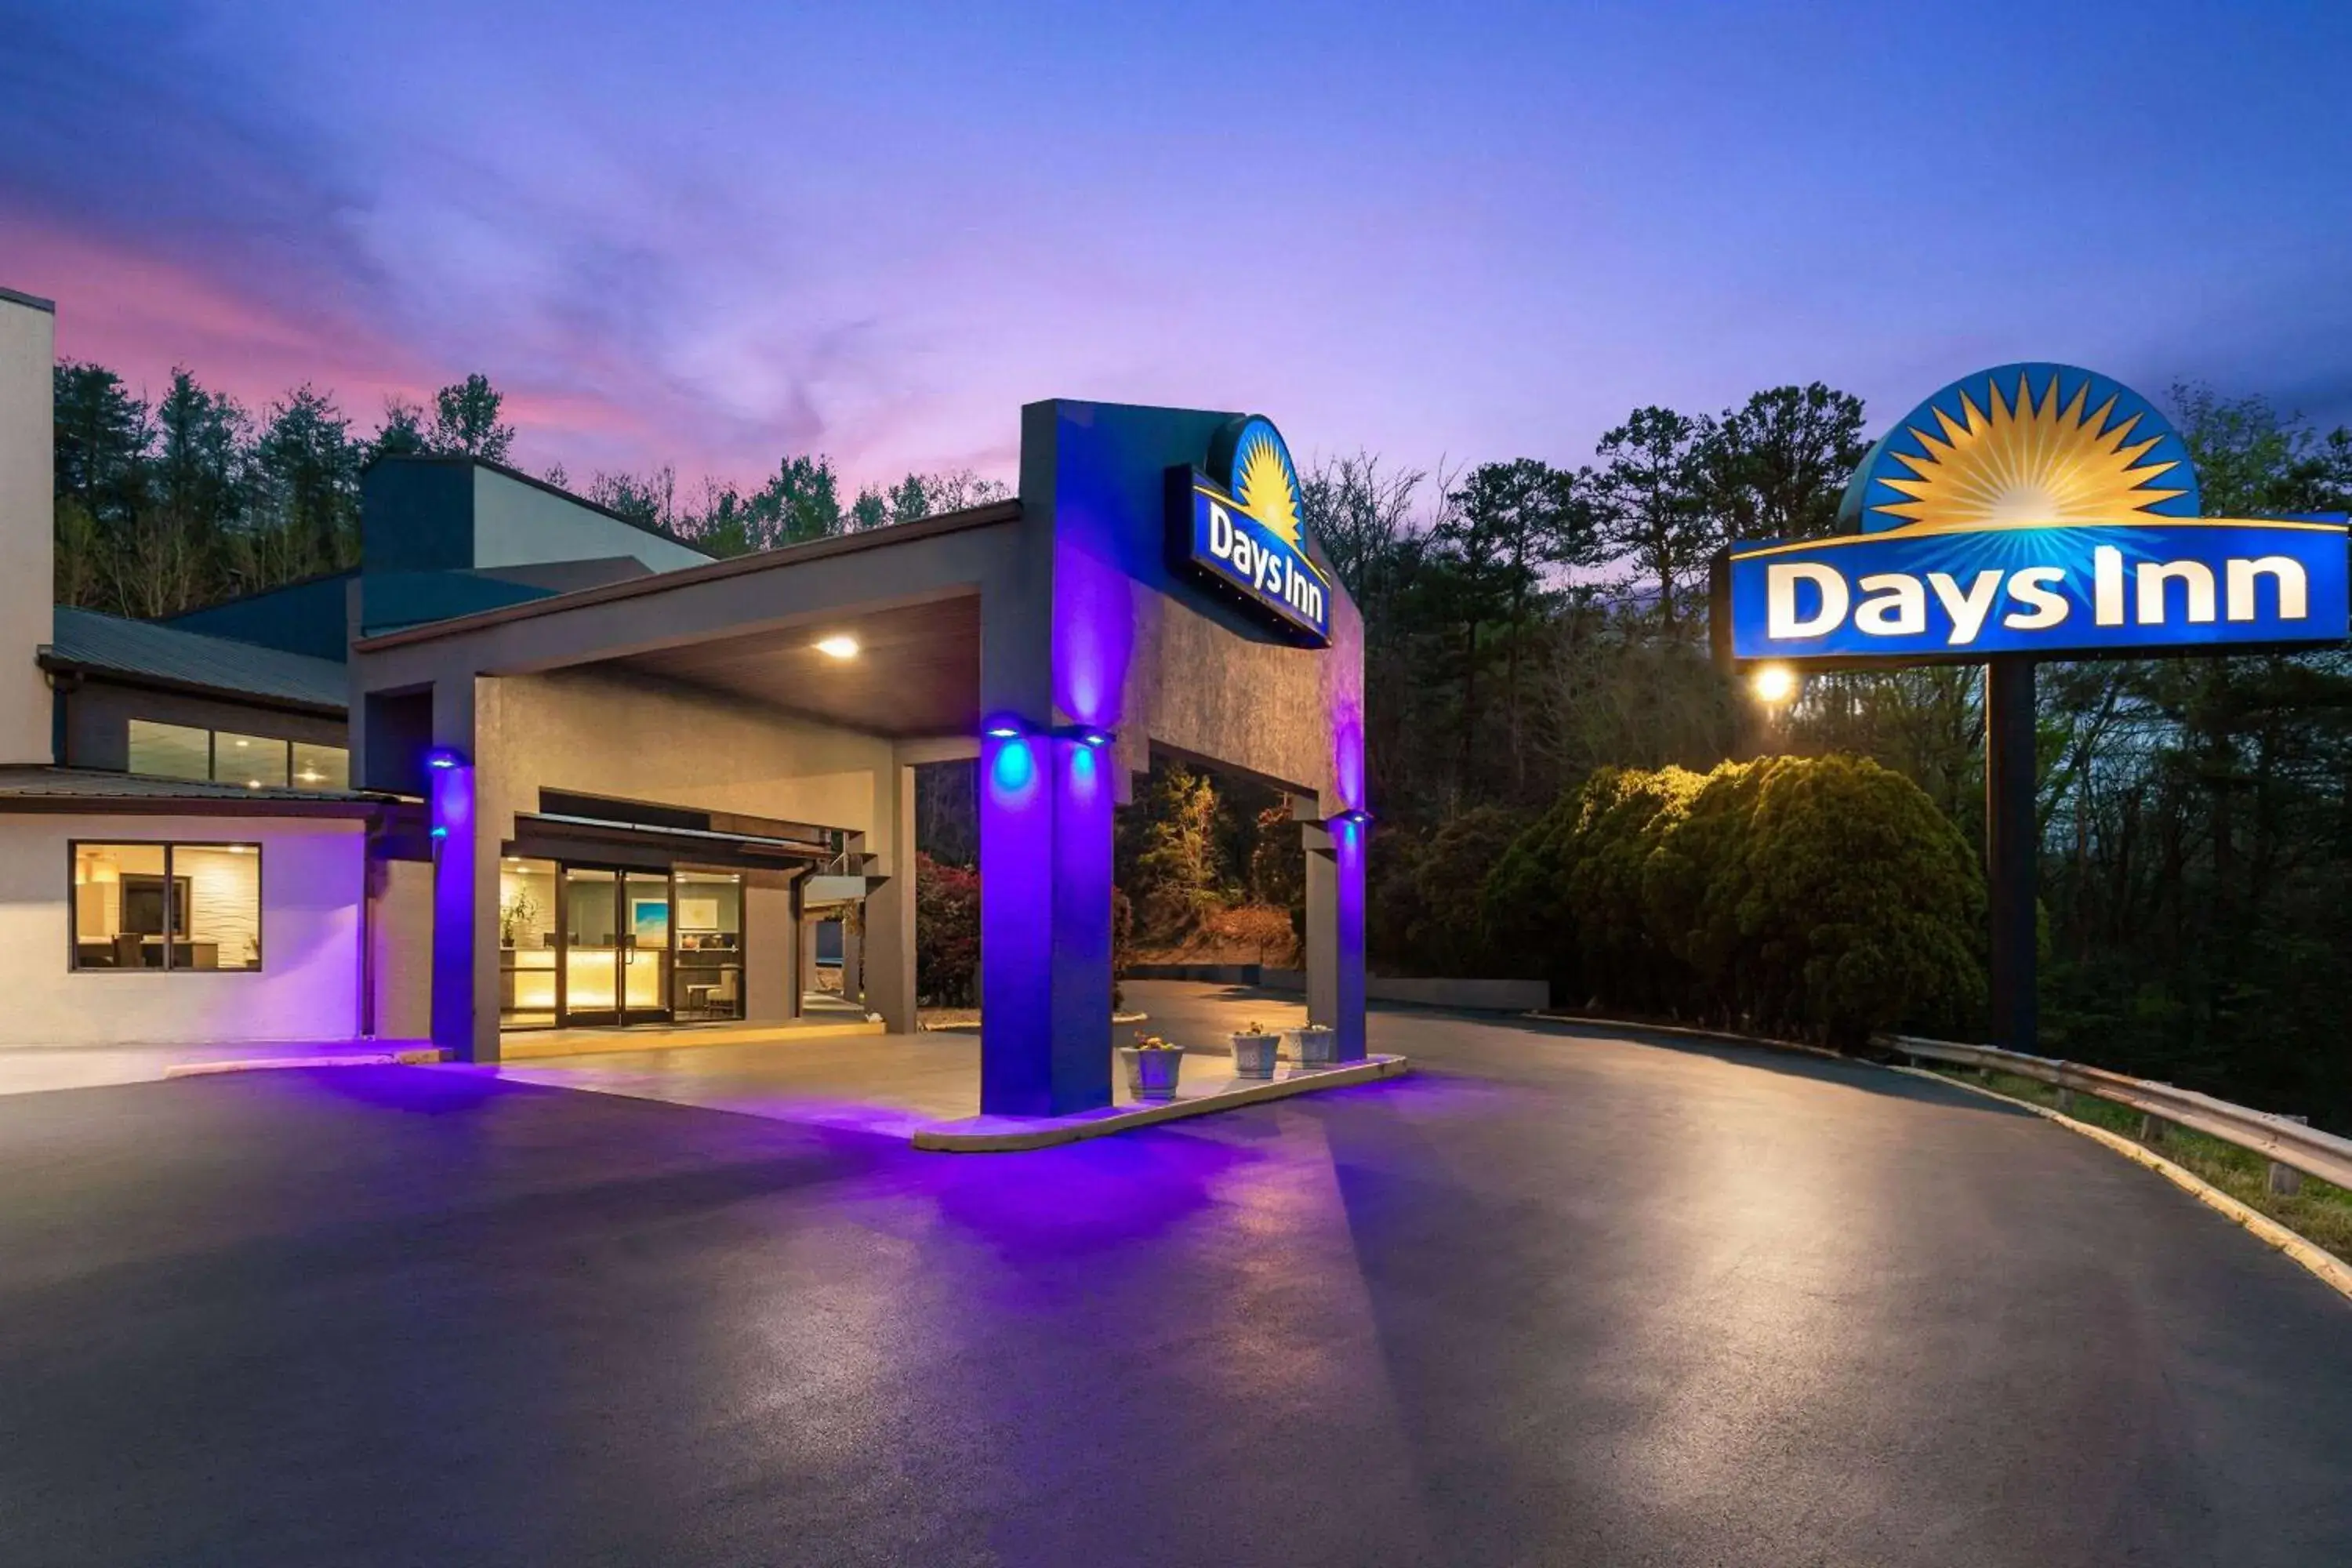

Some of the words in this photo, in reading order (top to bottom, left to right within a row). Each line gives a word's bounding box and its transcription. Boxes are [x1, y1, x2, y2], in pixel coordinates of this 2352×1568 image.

[1210, 501, 1282, 593] Days
[1286, 557, 1322, 623] Inn
[1768, 561, 2069, 644] Days
[2094, 545, 2307, 626] Inn
